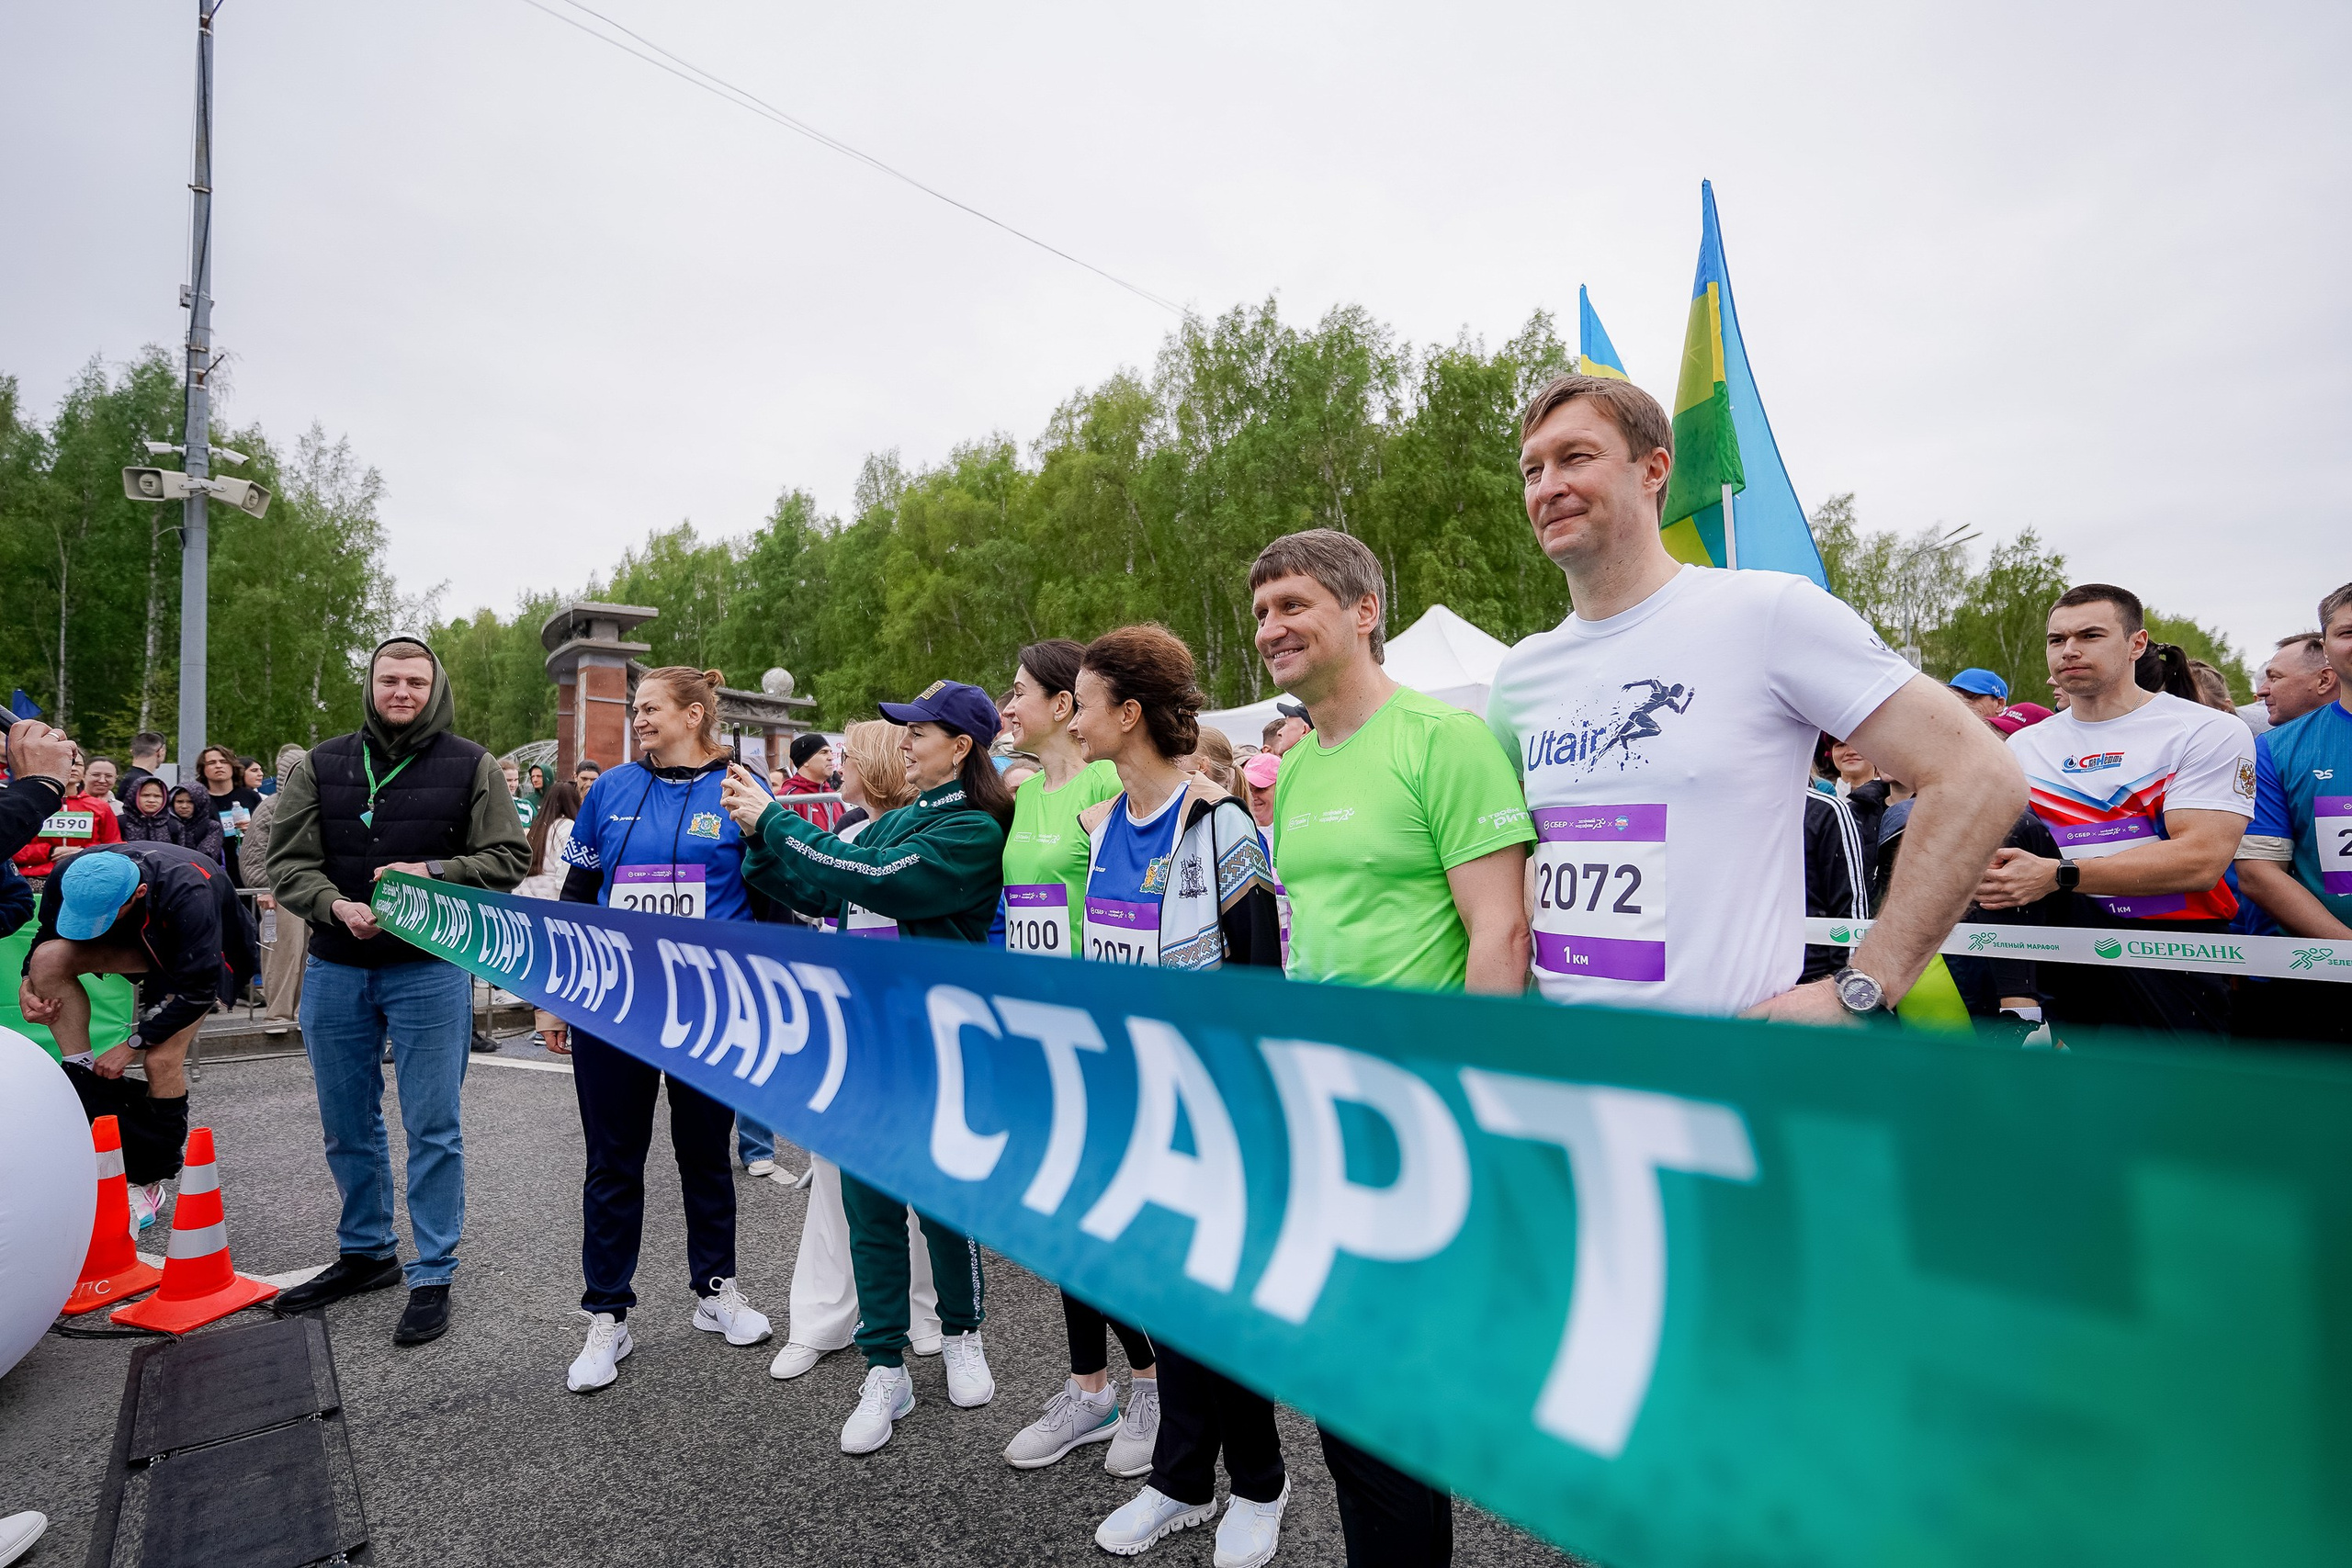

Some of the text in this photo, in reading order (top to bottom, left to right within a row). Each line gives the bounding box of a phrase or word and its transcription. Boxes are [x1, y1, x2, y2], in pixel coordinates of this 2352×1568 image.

[1528, 720, 1607, 772] Utair
[45, 818, 87, 829] 1590
[1550, 820, 1568, 829] СБЕР
[1540, 863, 1642, 914] 2072
[623, 894, 695, 917] 2000
[1009, 919, 1059, 951] 2100
[1992, 942, 2060, 952] ЗЕЛЕНЫЙ МАРАФОН
[2127, 940, 2245, 961] СБЕРБАНК
[395, 883, 1762, 1461] СТАРТ СТАРТ СТАРТ СТАРТ СТАРТ СТАРТ
[70, 1280, 111, 1298] ПС
